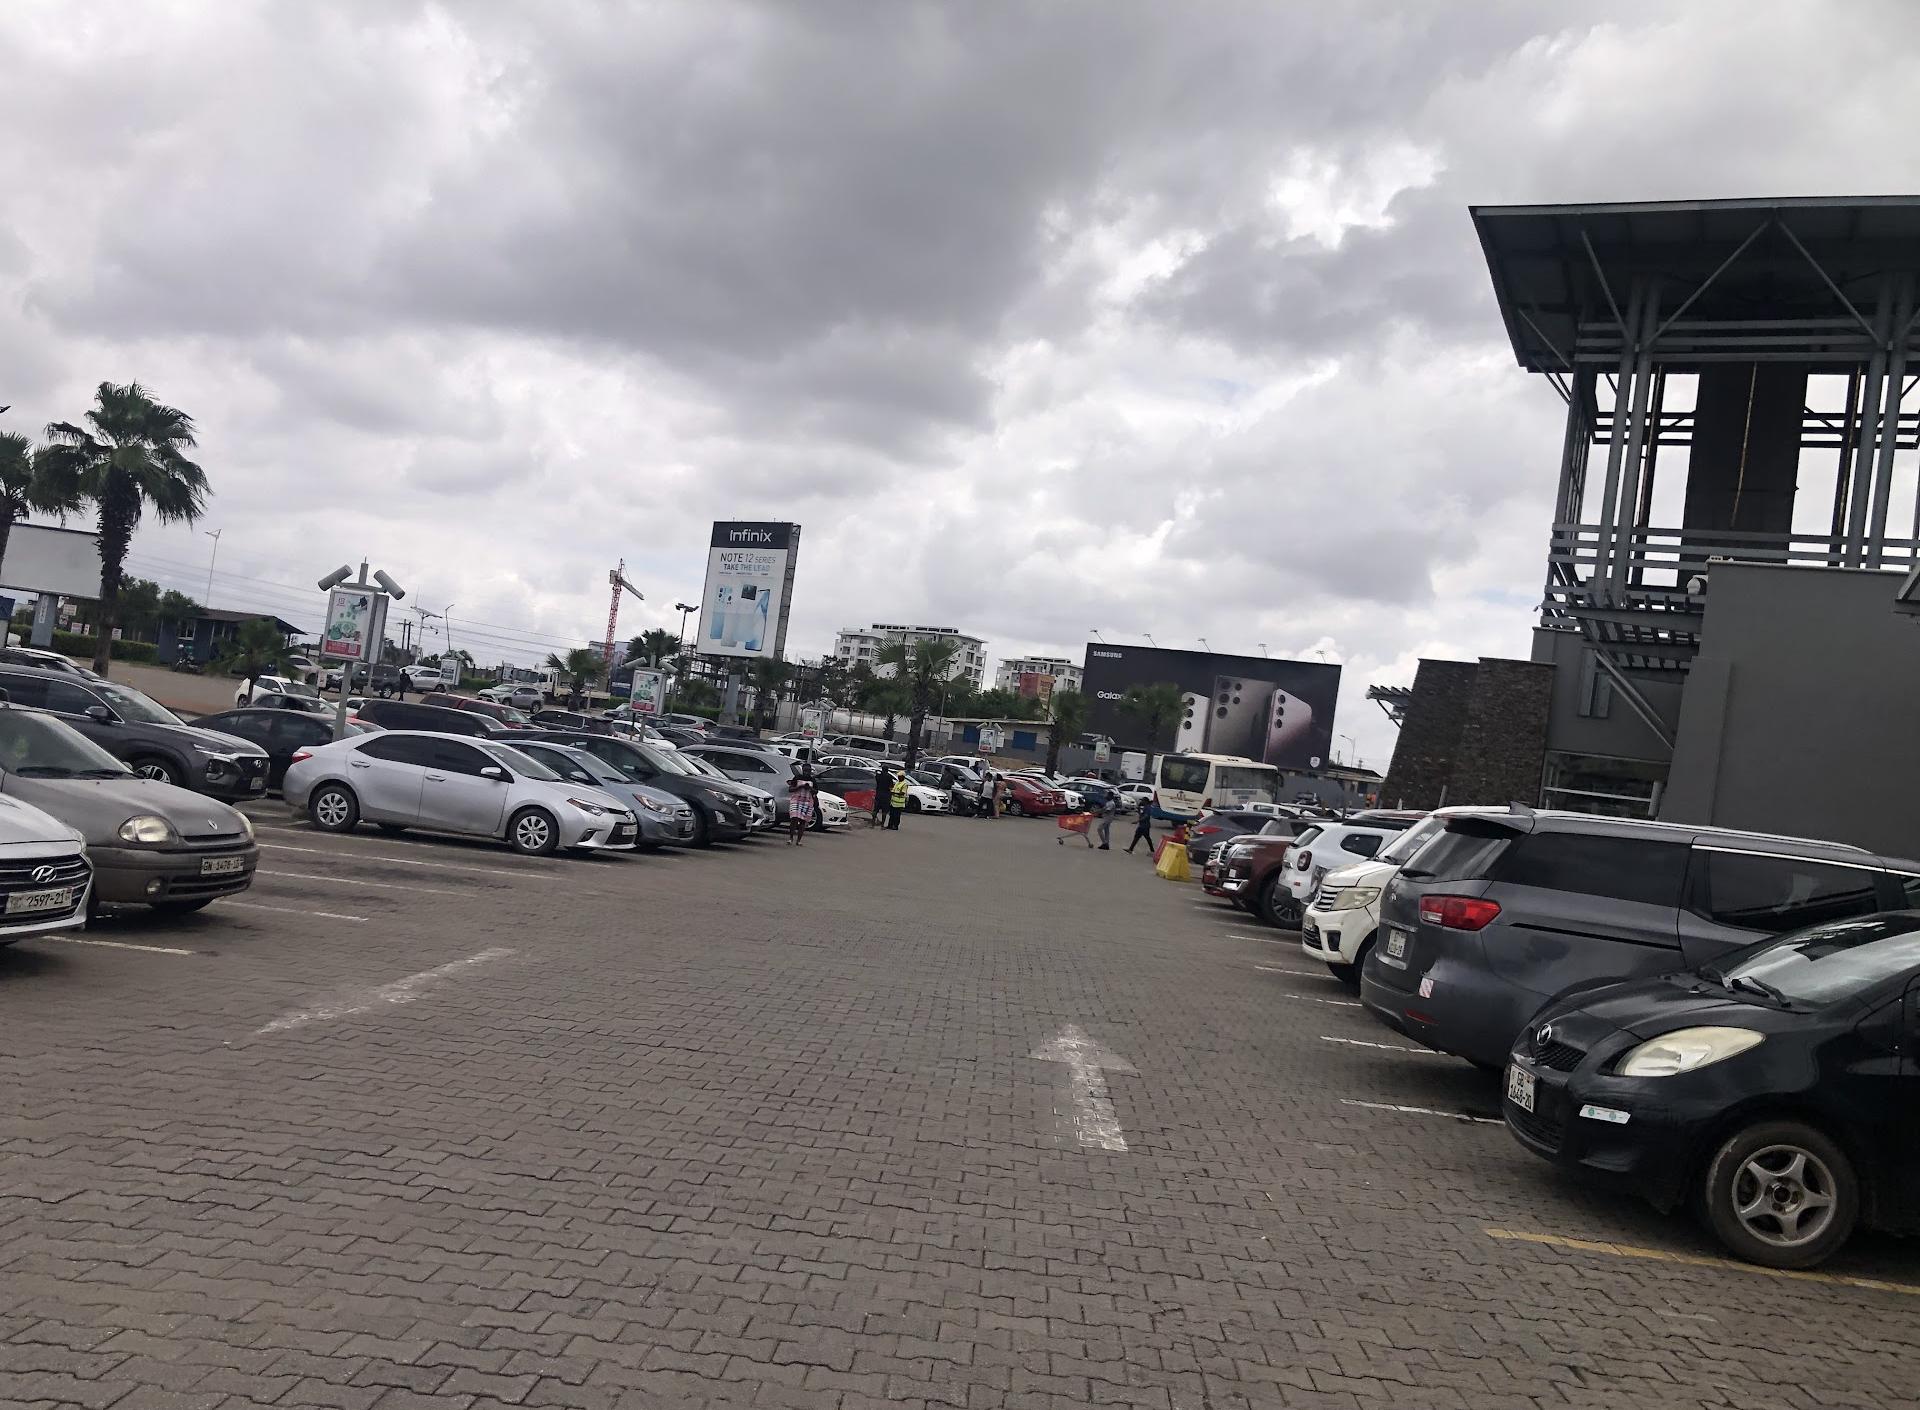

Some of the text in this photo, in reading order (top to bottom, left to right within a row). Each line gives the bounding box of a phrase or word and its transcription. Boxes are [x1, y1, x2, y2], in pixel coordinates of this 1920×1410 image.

[730, 529, 772, 542] Infinix
[720, 552, 743, 563] NOTE
[745, 553, 754, 563] 12
[724, 563, 739, 571] TAKE
[740, 563, 752, 572] THE
[1093, 650, 1122, 659] SAMSUNG
